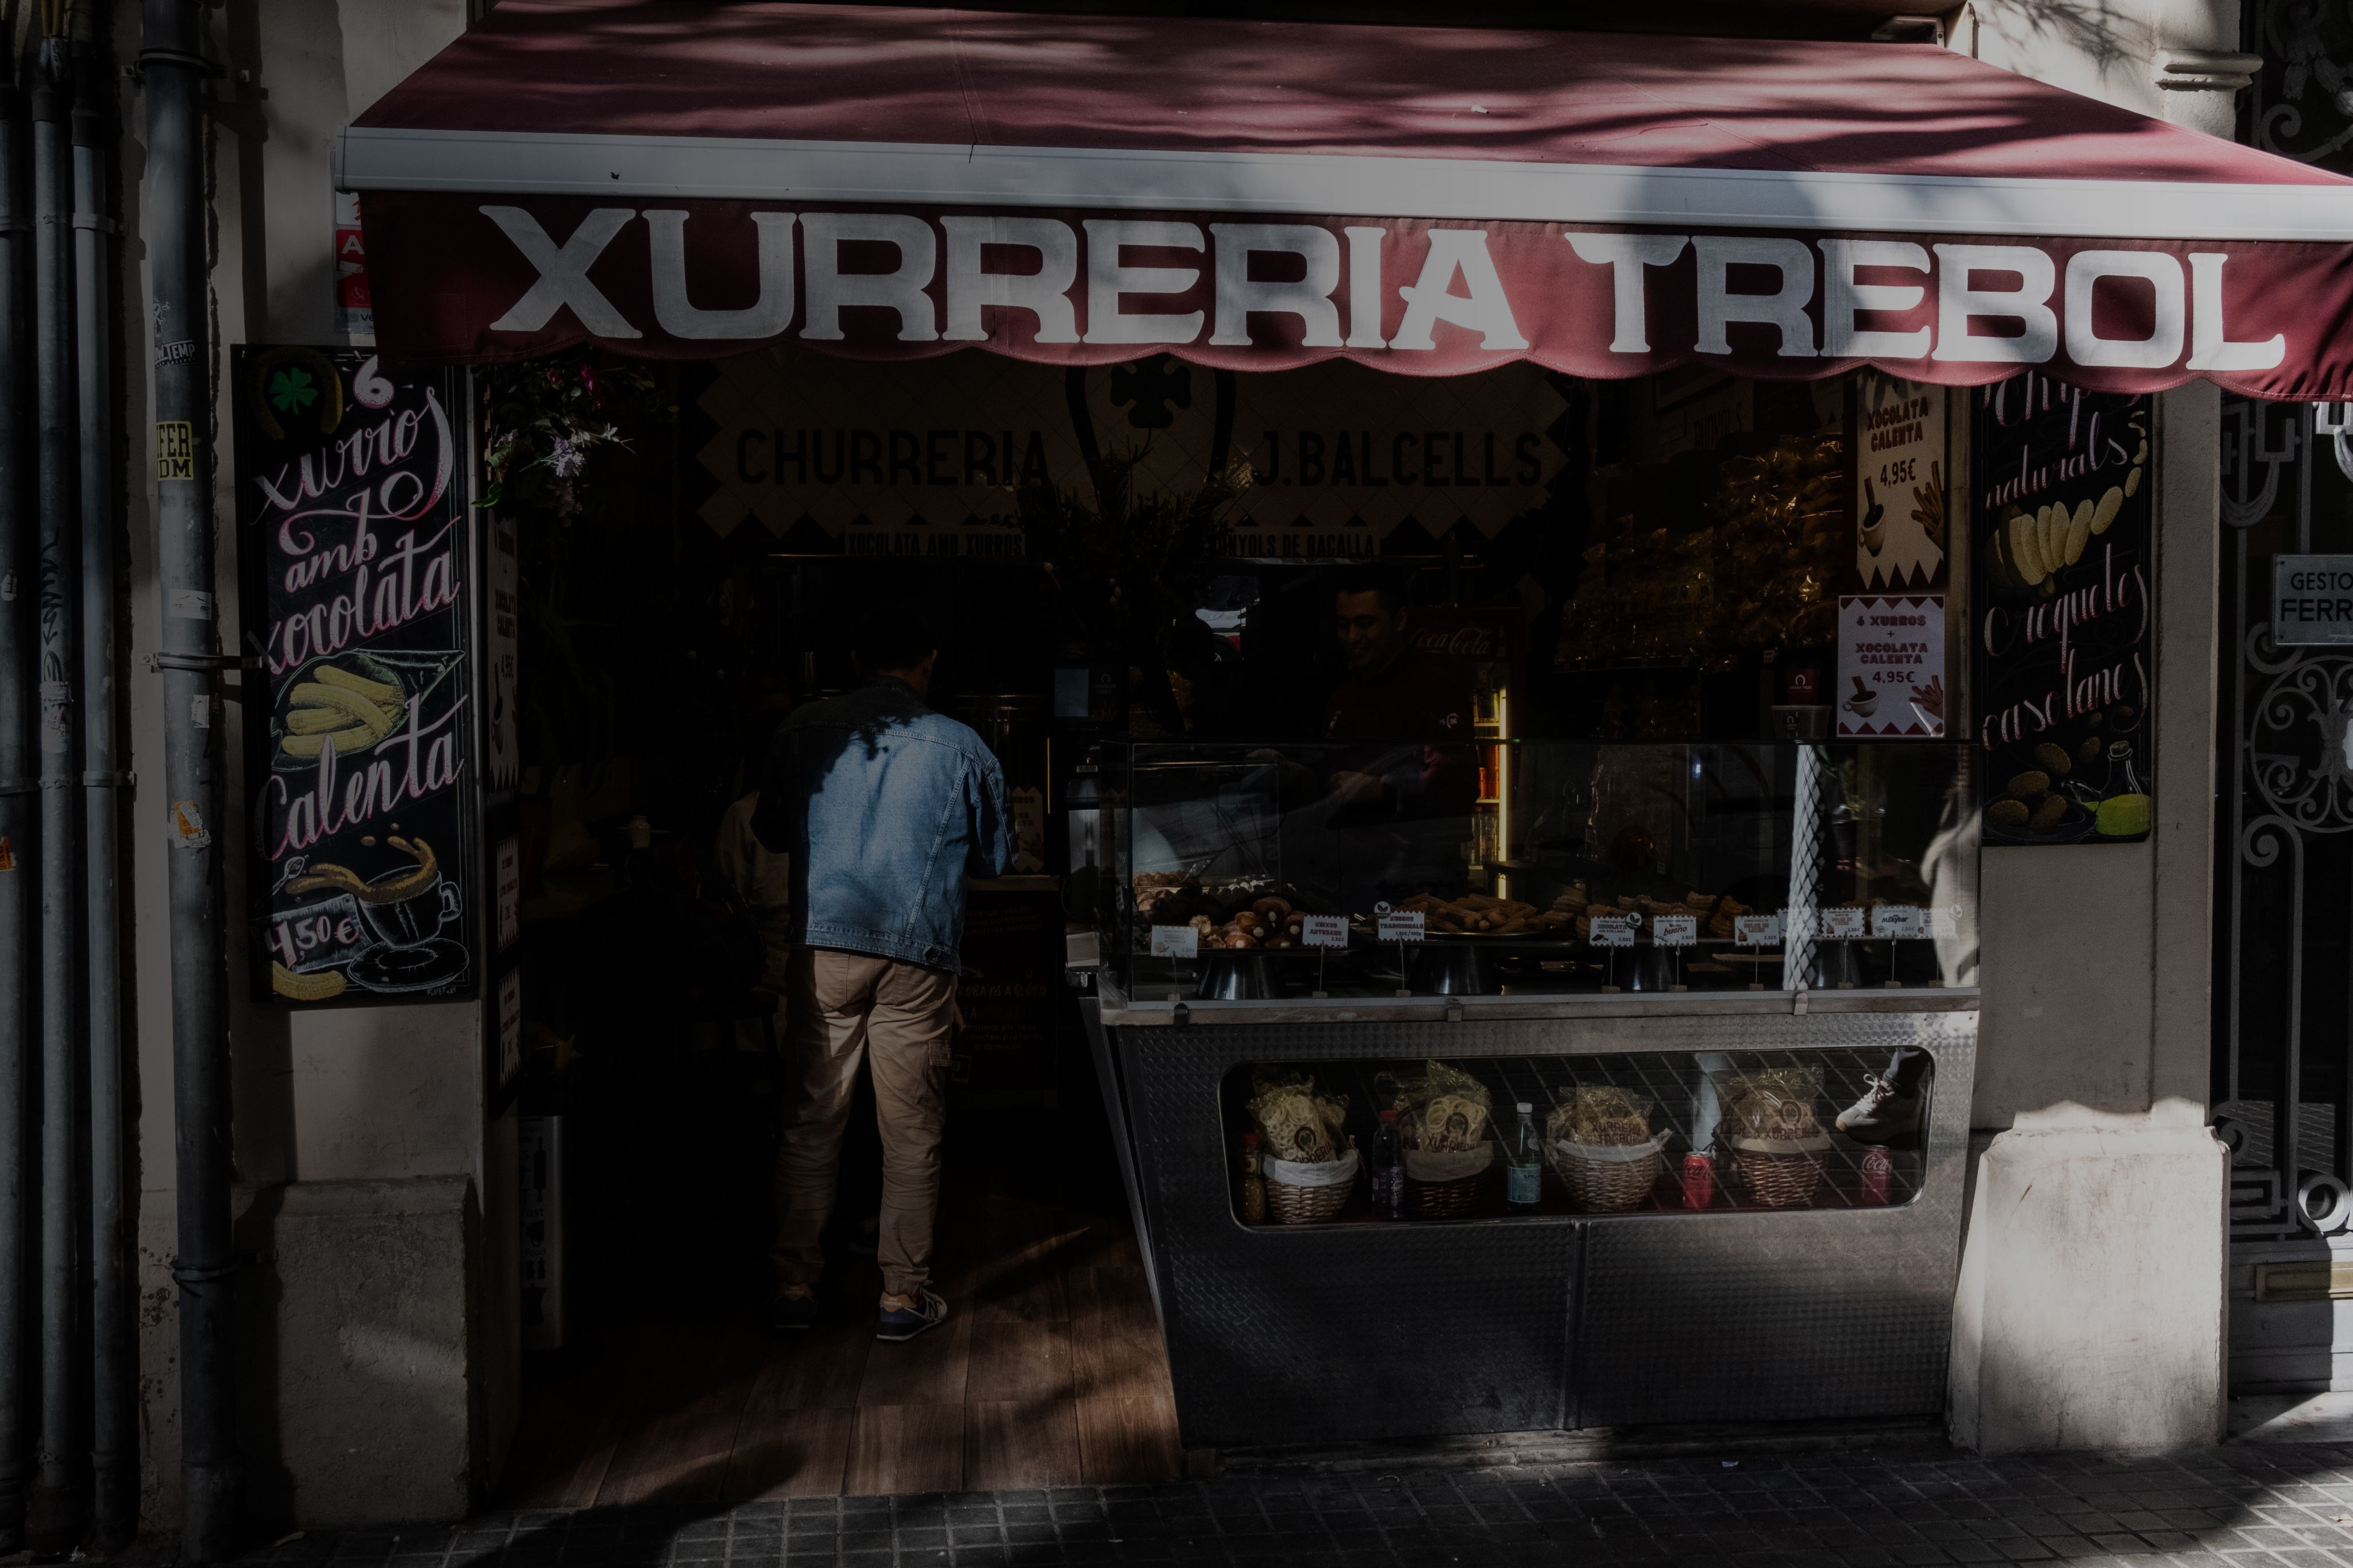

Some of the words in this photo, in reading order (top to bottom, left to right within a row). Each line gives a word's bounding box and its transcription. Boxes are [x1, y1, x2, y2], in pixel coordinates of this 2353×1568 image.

[479, 205, 1529, 350] XURRERIA
[1564, 232, 2286, 370] TREBOL
[352, 354, 395, 410] 6
[1868, 396, 1928, 431] XOCOLATA
[1871, 420, 1923, 452] CALENTA
[736, 428, 1049, 486] CHURRERIA
[1252, 431, 1544, 487] J.BALCELLS
[1880, 457, 1916, 489] 4,95€
[284, 487, 378, 593] amb
[849, 532, 920, 556] XOCOLATA
[927, 532, 959, 556] AMB
[966, 532, 1023, 556] XURROS
[1211, 534, 1276, 557] UNYOLS
[1282, 535, 1300, 557] DE
[1307, 535, 1374, 557] BACALLA
[246, 515, 462, 675] xocolata
[1856, 615, 1865, 626] 6
[1870, 615, 1927, 627] XURROS
[1855, 642, 1928, 654] XOCOLATA
[1860, 653, 1923, 665] CALENTA
[1872, 671, 1915, 683] 4,95€
[1663, 926, 1687, 936] bueno
